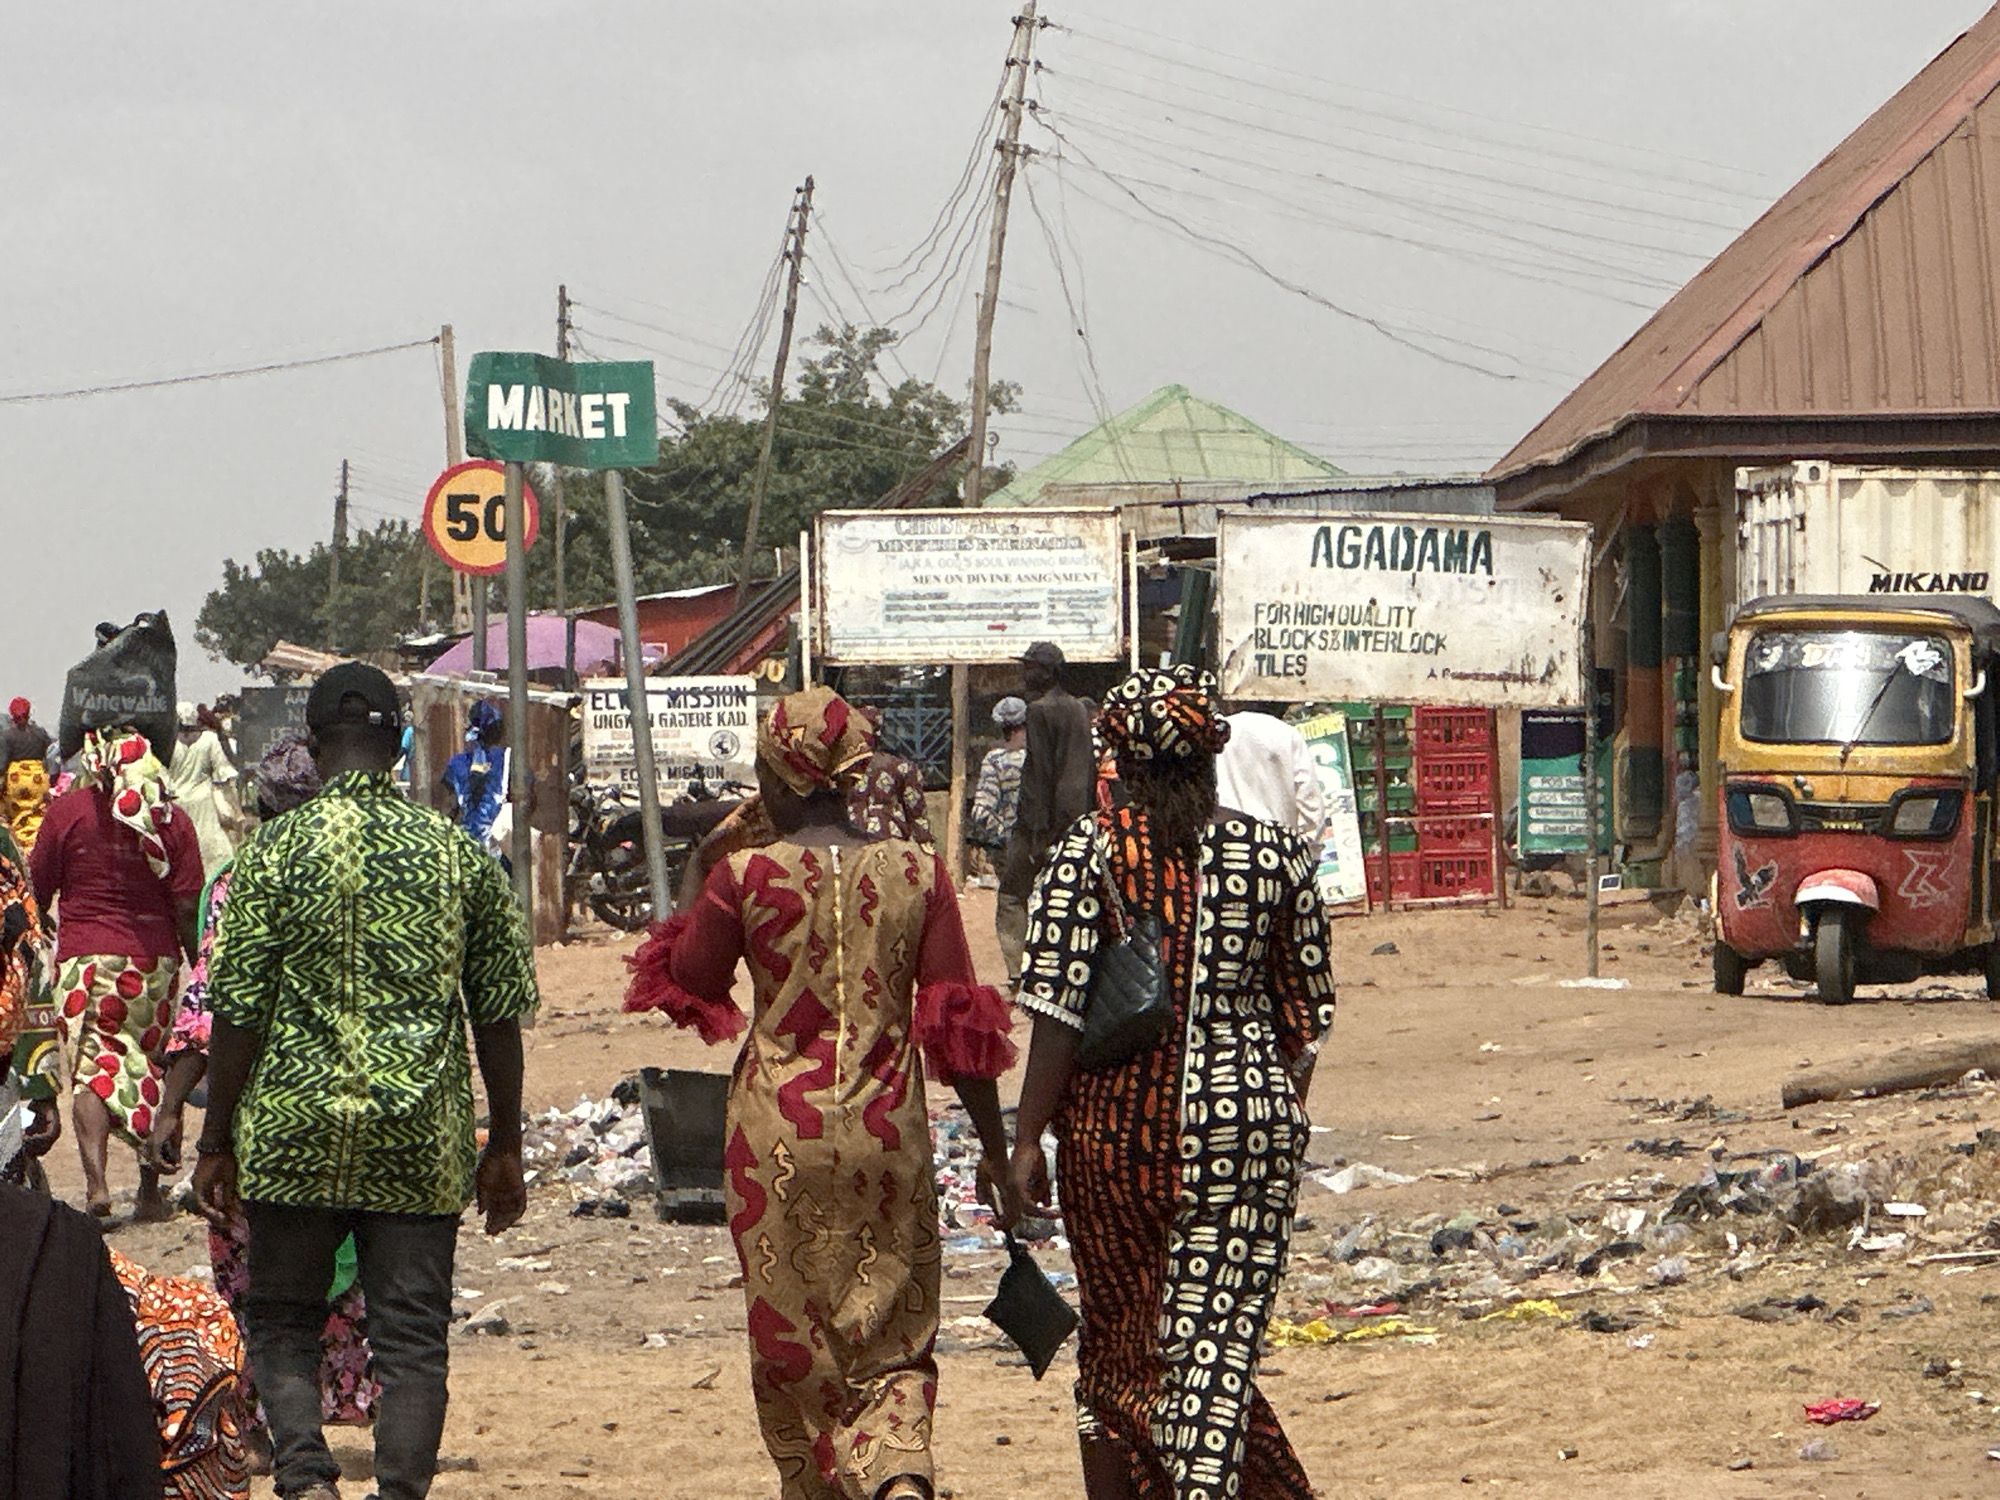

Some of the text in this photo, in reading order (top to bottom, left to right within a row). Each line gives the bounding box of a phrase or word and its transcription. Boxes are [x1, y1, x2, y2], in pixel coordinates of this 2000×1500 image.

[487, 384, 630, 439] MARKET
[446, 494, 507, 541] 50
[1310, 526, 1494, 576] AGADAMA
[912, 572, 1099, 585] MEN ON DIVINE ASSIGNMENT
[1868, 572, 1990, 593] MIKANO
[1254, 653, 1308, 677] TILES
[667, 686, 747, 709] MISSION
[658, 712, 713, 728] GAJERE
